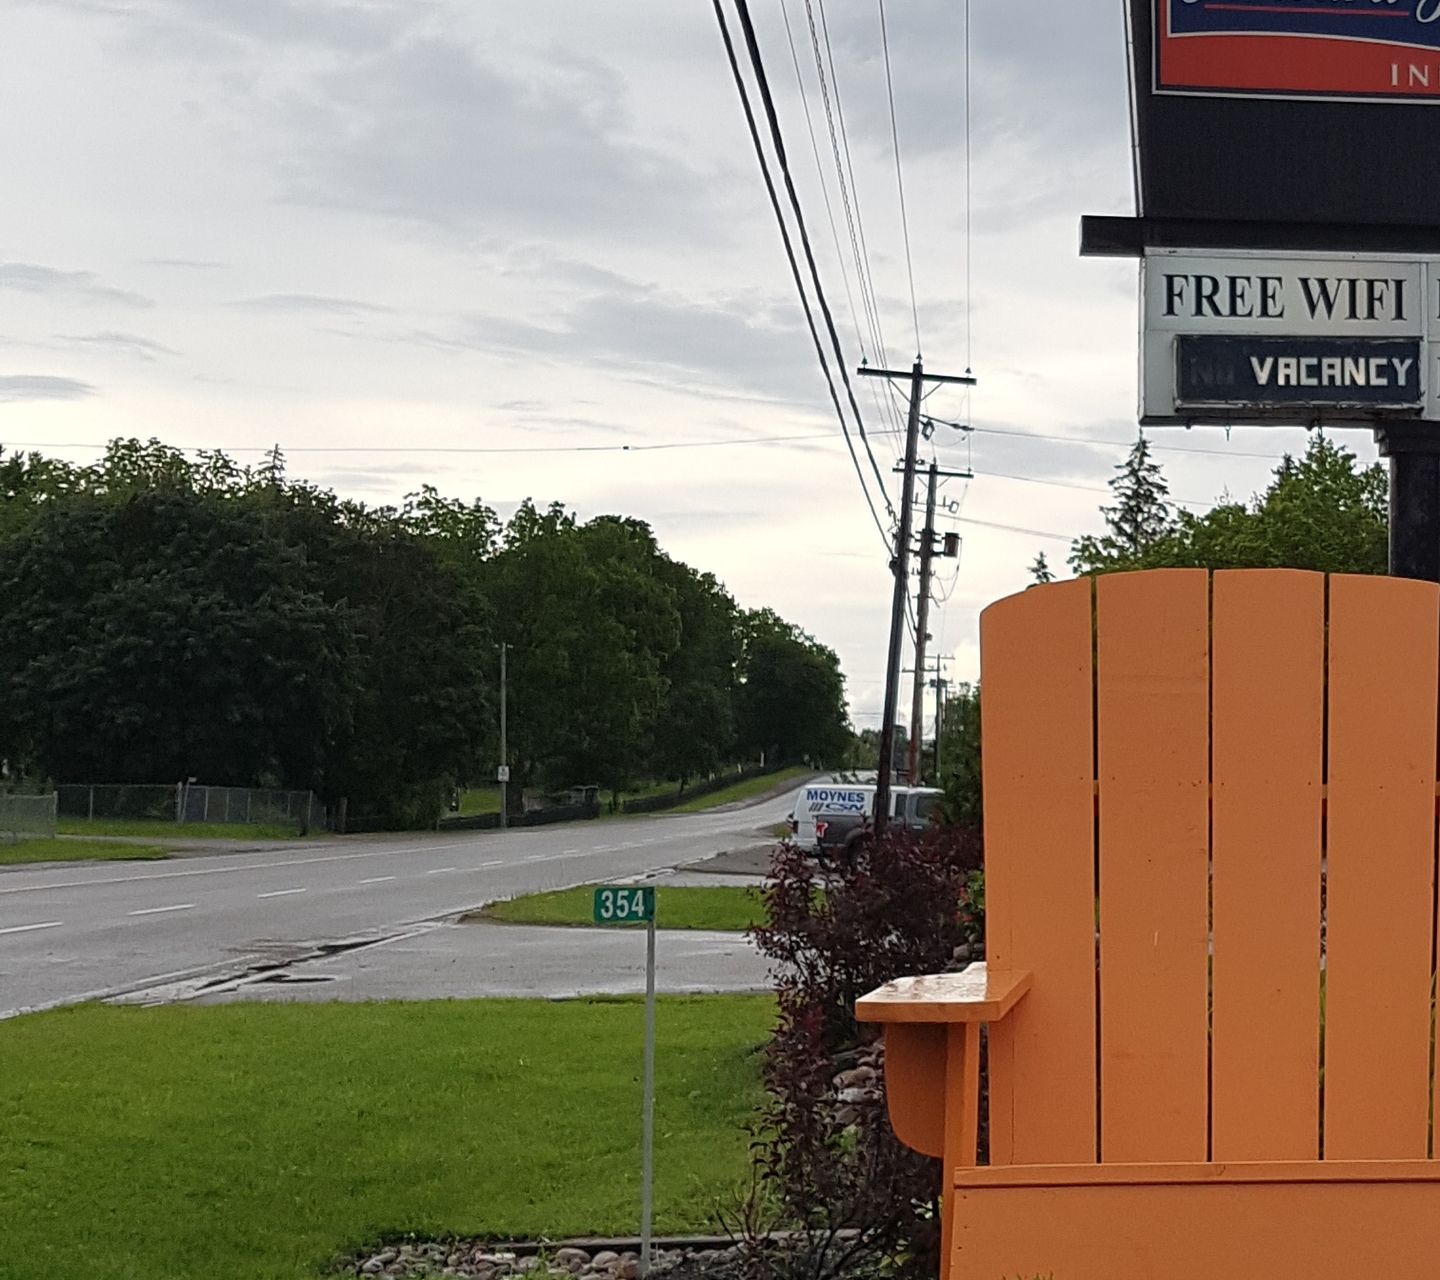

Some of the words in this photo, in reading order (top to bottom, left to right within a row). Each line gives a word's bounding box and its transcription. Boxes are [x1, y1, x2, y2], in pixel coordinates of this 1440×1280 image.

[1161, 273, 1286, 320] FREE
[1297, 276, 1408, 321] WIFI
[1250, 356, 1413, 387] VACANCY
[807, 789, 865, 803] MOYNES
[600, 889, 645, 919] 354
